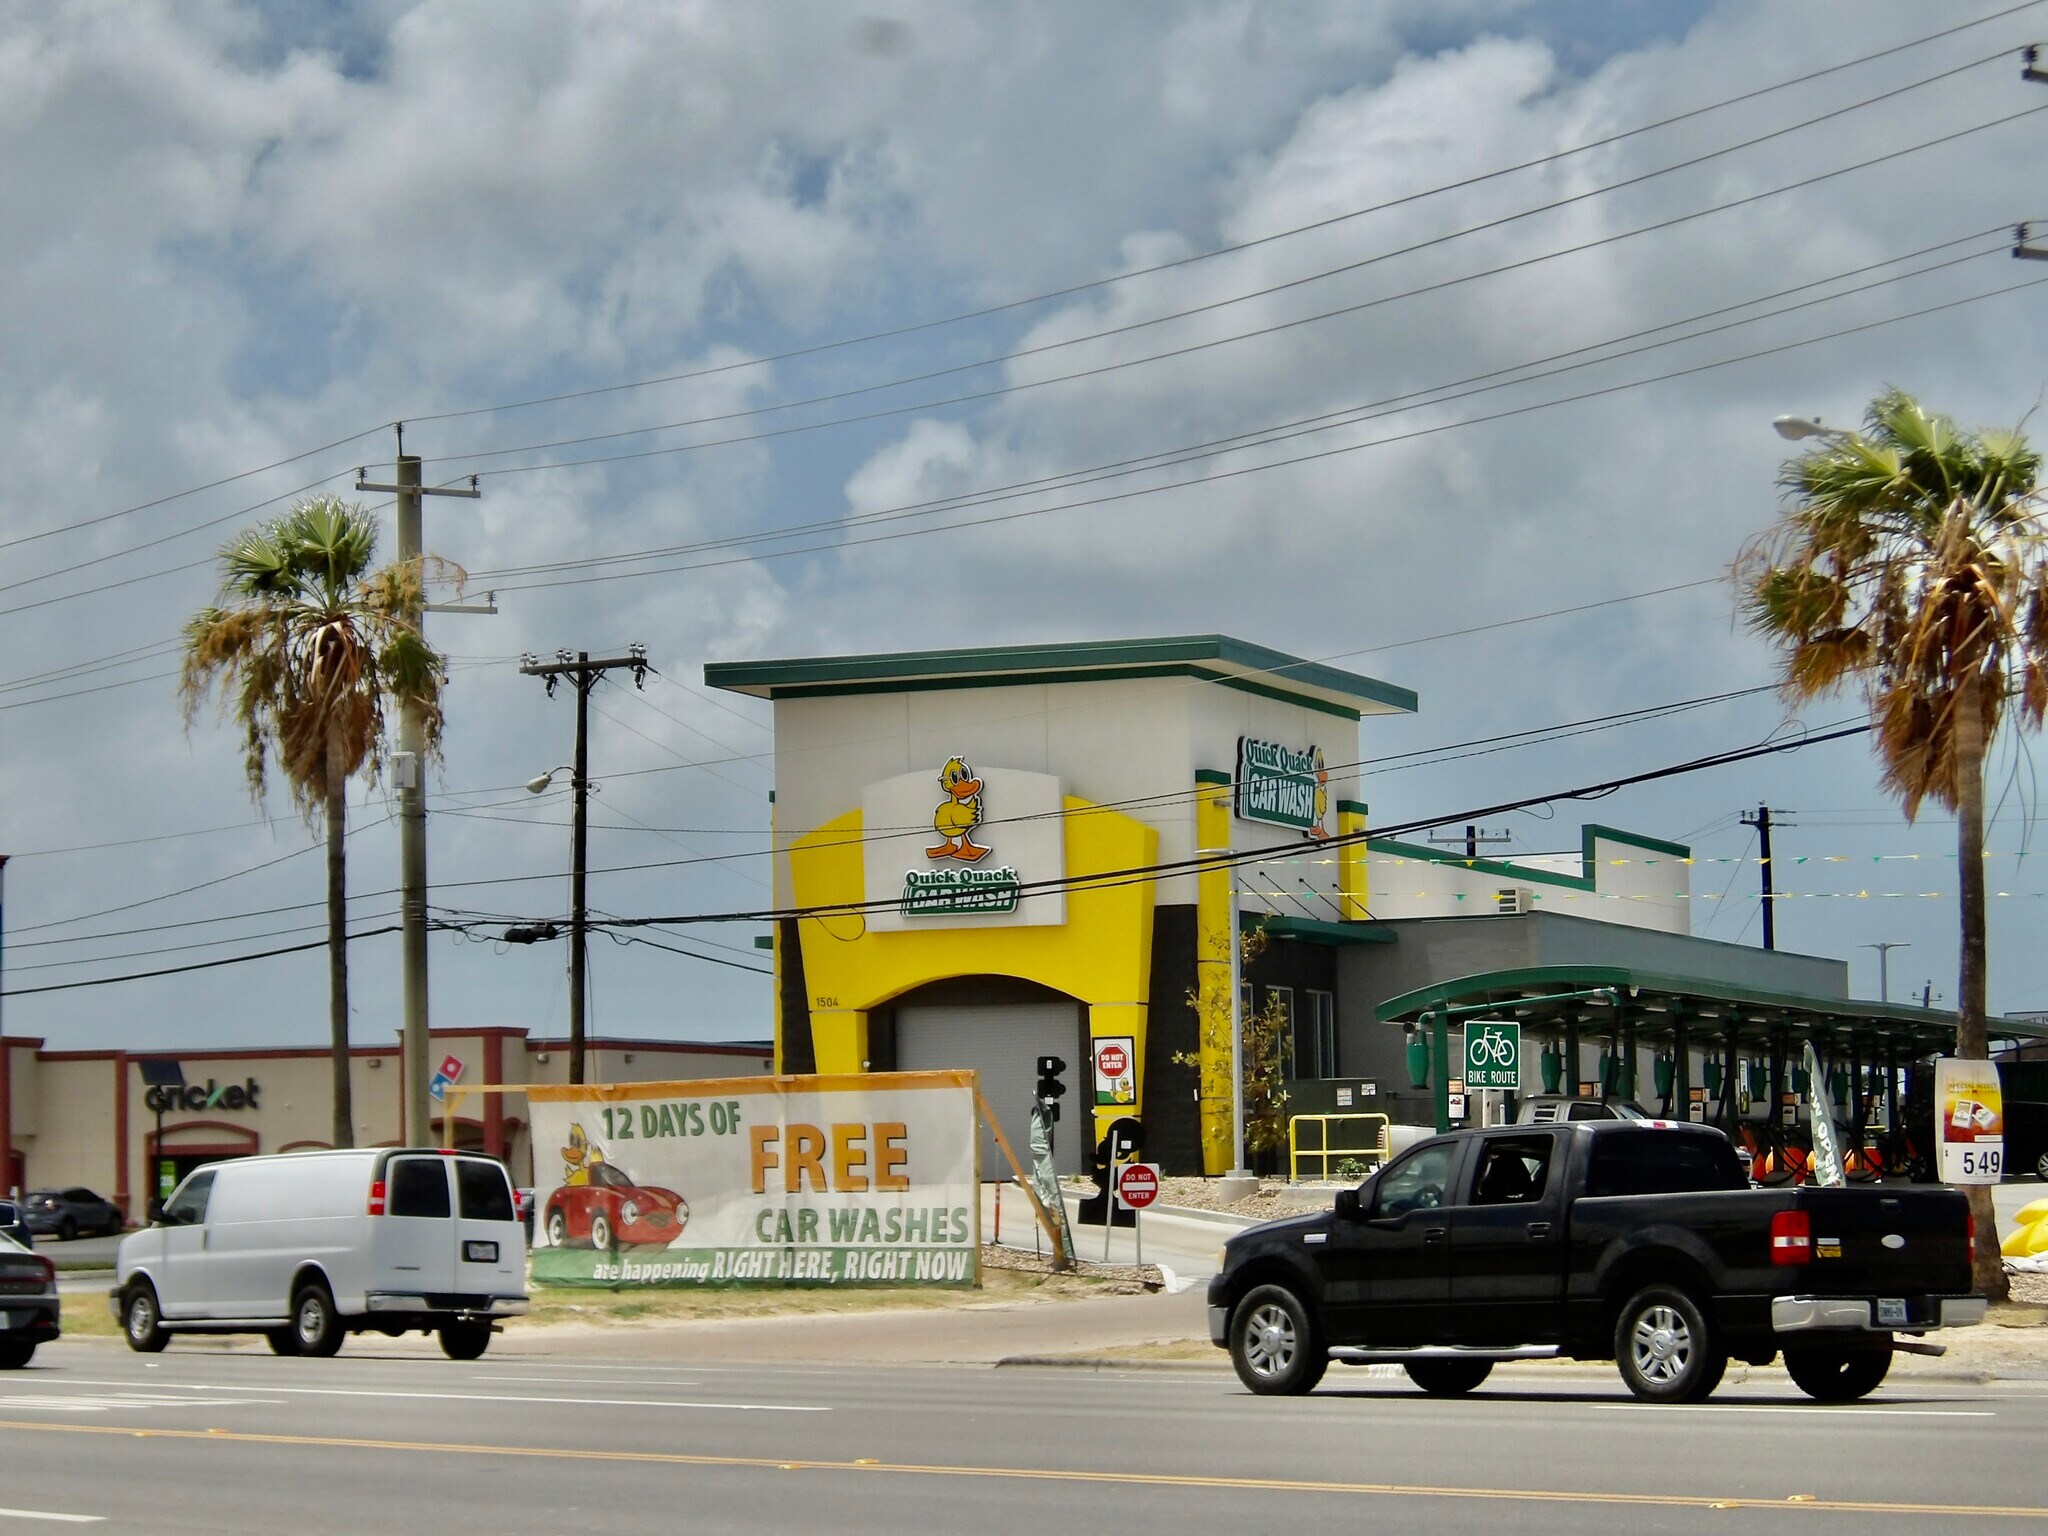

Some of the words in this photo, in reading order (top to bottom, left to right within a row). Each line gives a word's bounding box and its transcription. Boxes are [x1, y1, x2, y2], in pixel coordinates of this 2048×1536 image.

[1245, 738, 1279, 768] Quick
[1279, 746, 1314, 774] Quack
[1249, 773, 1277, 812] CAR
[1278, 778, 1314, 819] WASH
[905, 870, 957, 887] Quick
[959, 868, 1014, 886] Quack
[816, 997, 839, 1007] 1504
[1102, 1061, 1123, 1069] ENTER
[1110, 1053, 1124, 1061] NOT
[1468, 1070, 1487, 1084] BIKE
[1491, 1070, 1516, 1084] ROUTE
[601, 1107, 635, 1140] 12
[640, 1102, 704, 1138] DAYS
[709, 1101, 741, 1136] OF
[750, 1122, 910, 1193] FREE
[1125, 1173, 1136, 1181] DO
[1137, 1173, 1151, 1181] NOT
[1128, 1192, 1150, 1200] ENTER
[755, 1208, 818, 1243] CAR
[827, 1207, 969, 1243] WASHES
[592, 1262, 619, 1280] are
[621, 1258, 710, 1284] happening
[711, 1251, 776, 1279] RIGHT
[776, 1251, 839, 1283] HERE,
[843, 1251, 912, 1280] RIGHT
[915, 1252, 968, 1281] NOW
